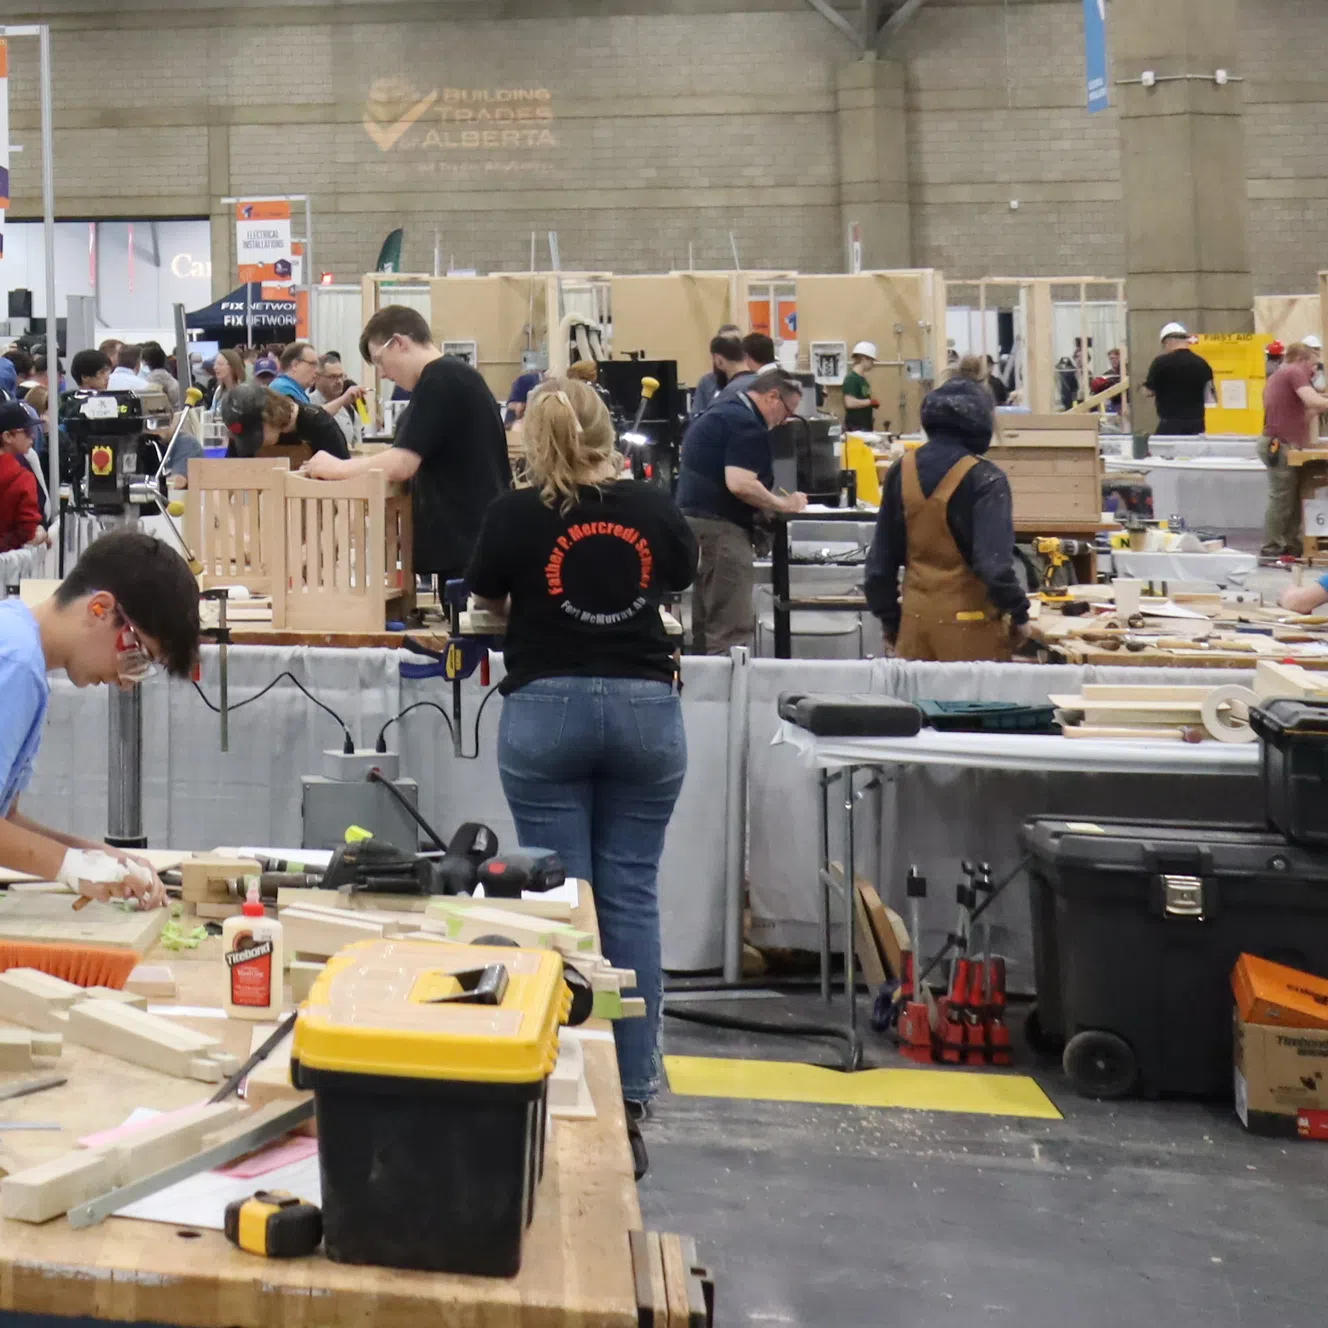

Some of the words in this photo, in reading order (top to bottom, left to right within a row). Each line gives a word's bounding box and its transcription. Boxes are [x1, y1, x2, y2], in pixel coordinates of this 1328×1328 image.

[443, 88, 552, 101] BUILDING
[220, 302, 244, 310] FIX
[249, 302, 297, 310] NETWO
[224, 315, 244, 326] FIX
[1316, 513, 1325, 525] 6
[567, 522, 640, 544] Mercredi
[560, 600, 581, 618] Fort
[226, 941, 271, 965] Titebond
